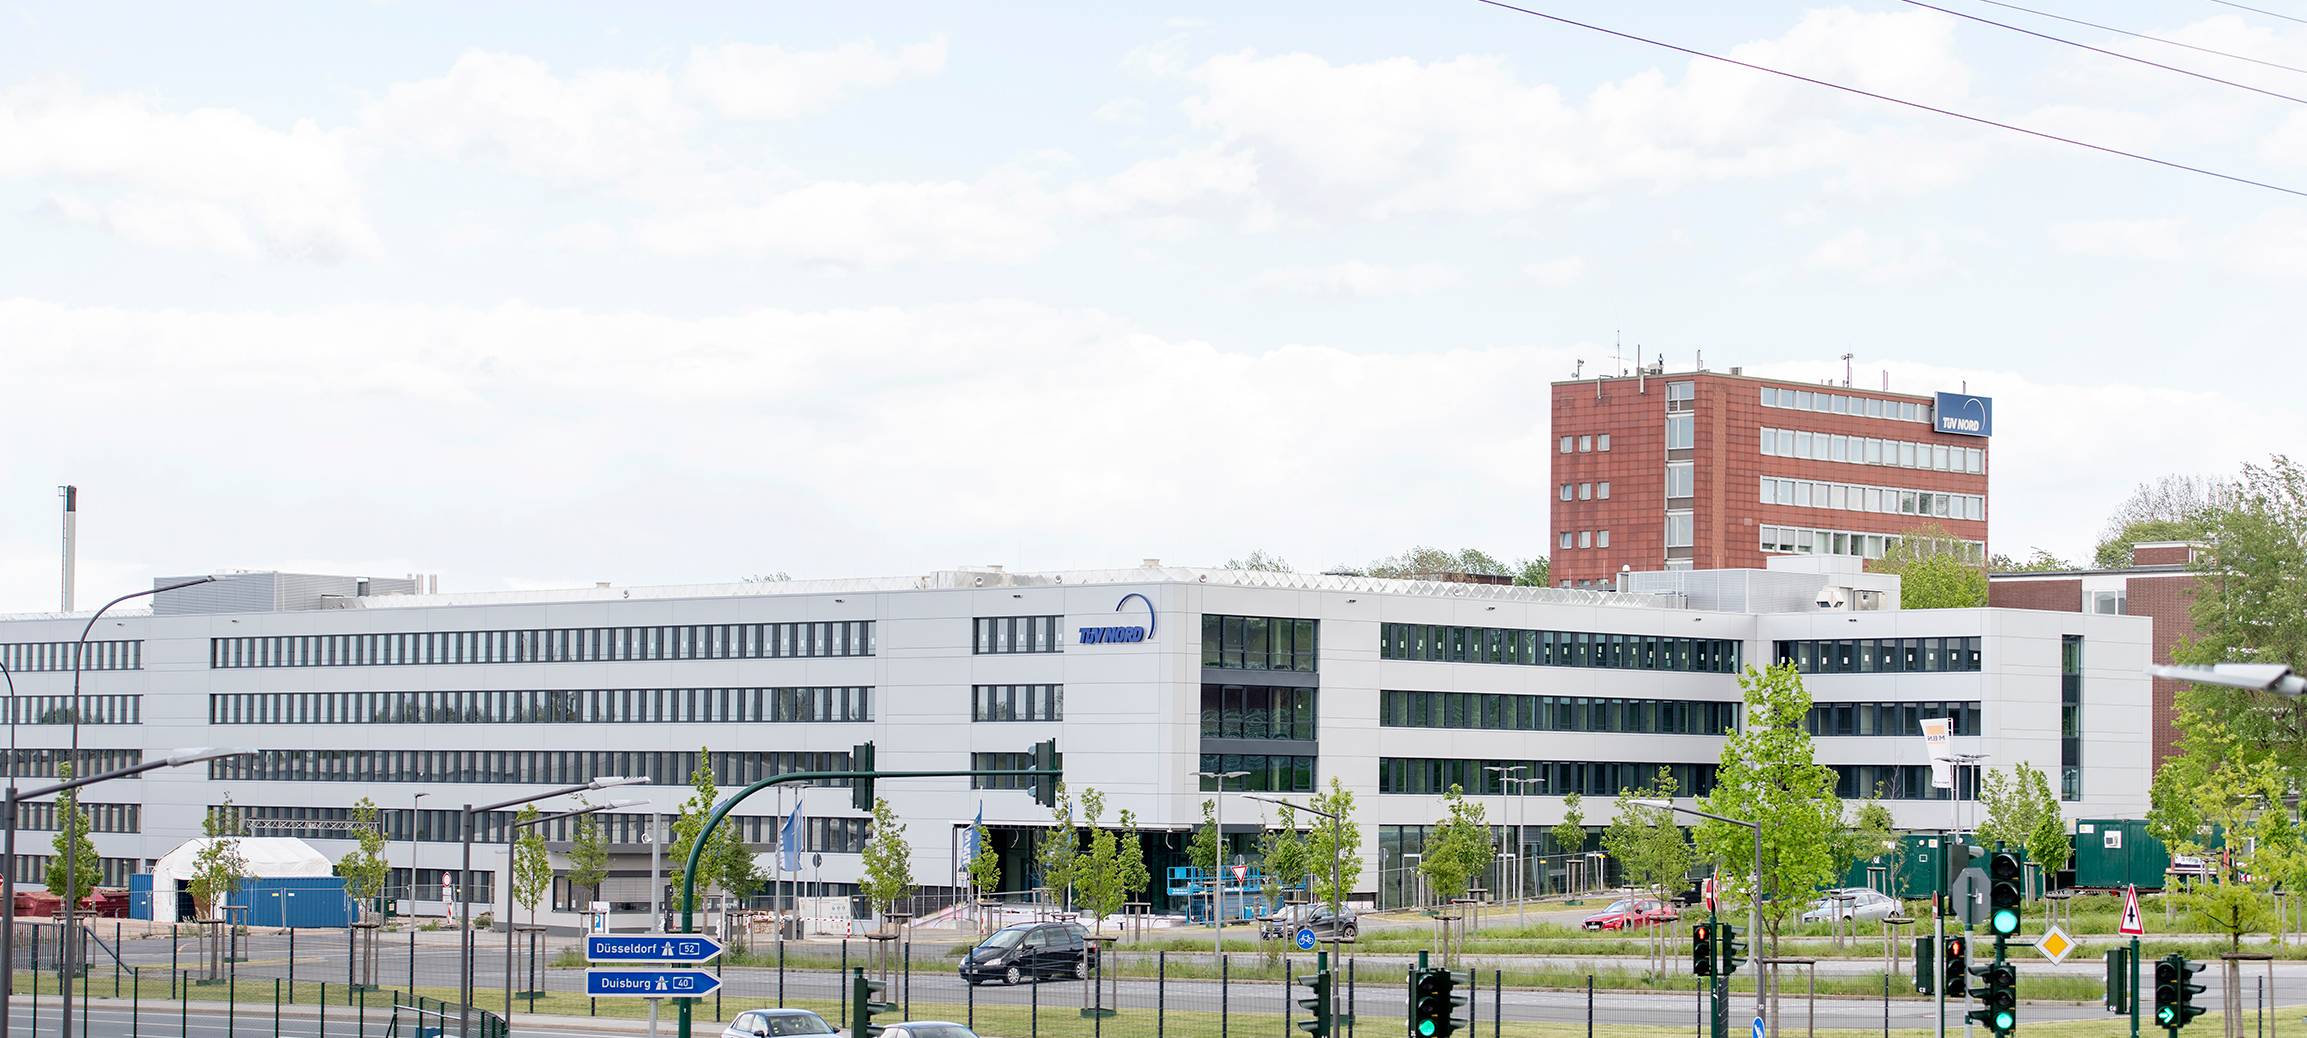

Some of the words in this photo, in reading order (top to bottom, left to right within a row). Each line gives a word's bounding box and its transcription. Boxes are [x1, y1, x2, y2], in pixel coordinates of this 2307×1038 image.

[1943, 417, 1957, 429] TÜV
[1957, 419, 1979, 431] NORD
[1079, 627, 1106, 643] TÜV
[1104, 627, 1144, 642] NORD
[596, 943, 656, 954] Düsseldorf
[684, 945, 694, 953] 52
[602, 978, 650, 990] Duisburg
[678, 979, 688, 987] 40
